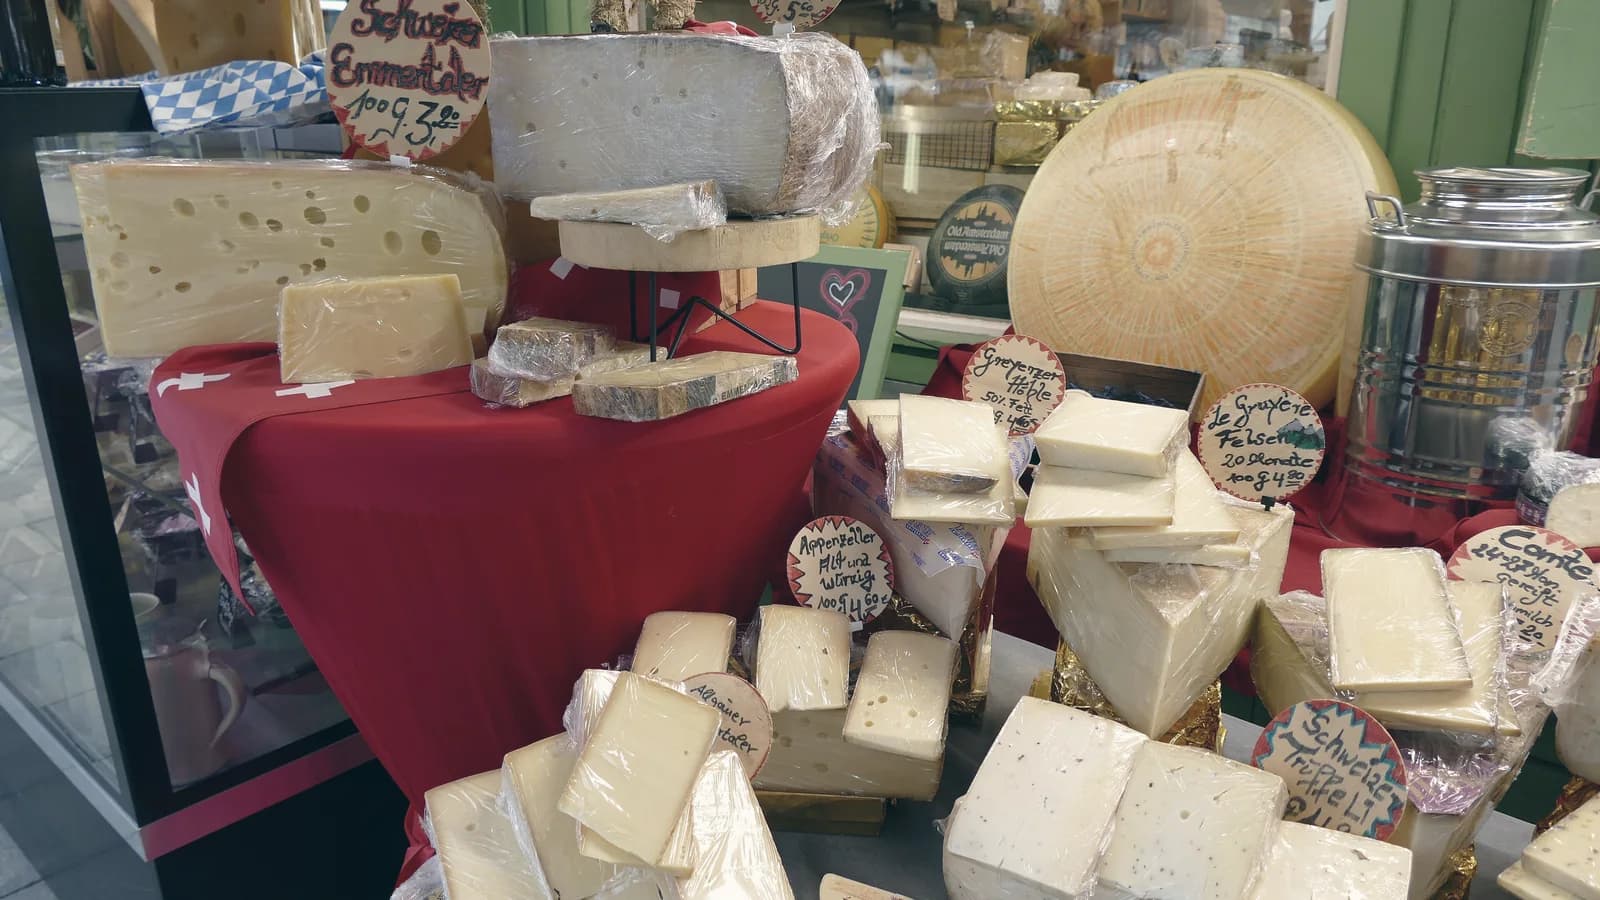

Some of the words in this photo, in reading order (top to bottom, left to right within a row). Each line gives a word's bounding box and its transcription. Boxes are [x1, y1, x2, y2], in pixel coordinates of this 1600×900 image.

[330, 42, 489, 103] Emmentaler
[973, 347, 1063, 381] Greyerzer
[1009, 398, 1033, 415] Fett
[1208, 405, 1230, 430] Le
[1221, 453, 1245, 468] 20
[799, 526, 876, 557] Appenzeller
[819, 551, 846, 575] Alt
[847, 553, 872, 568] und
